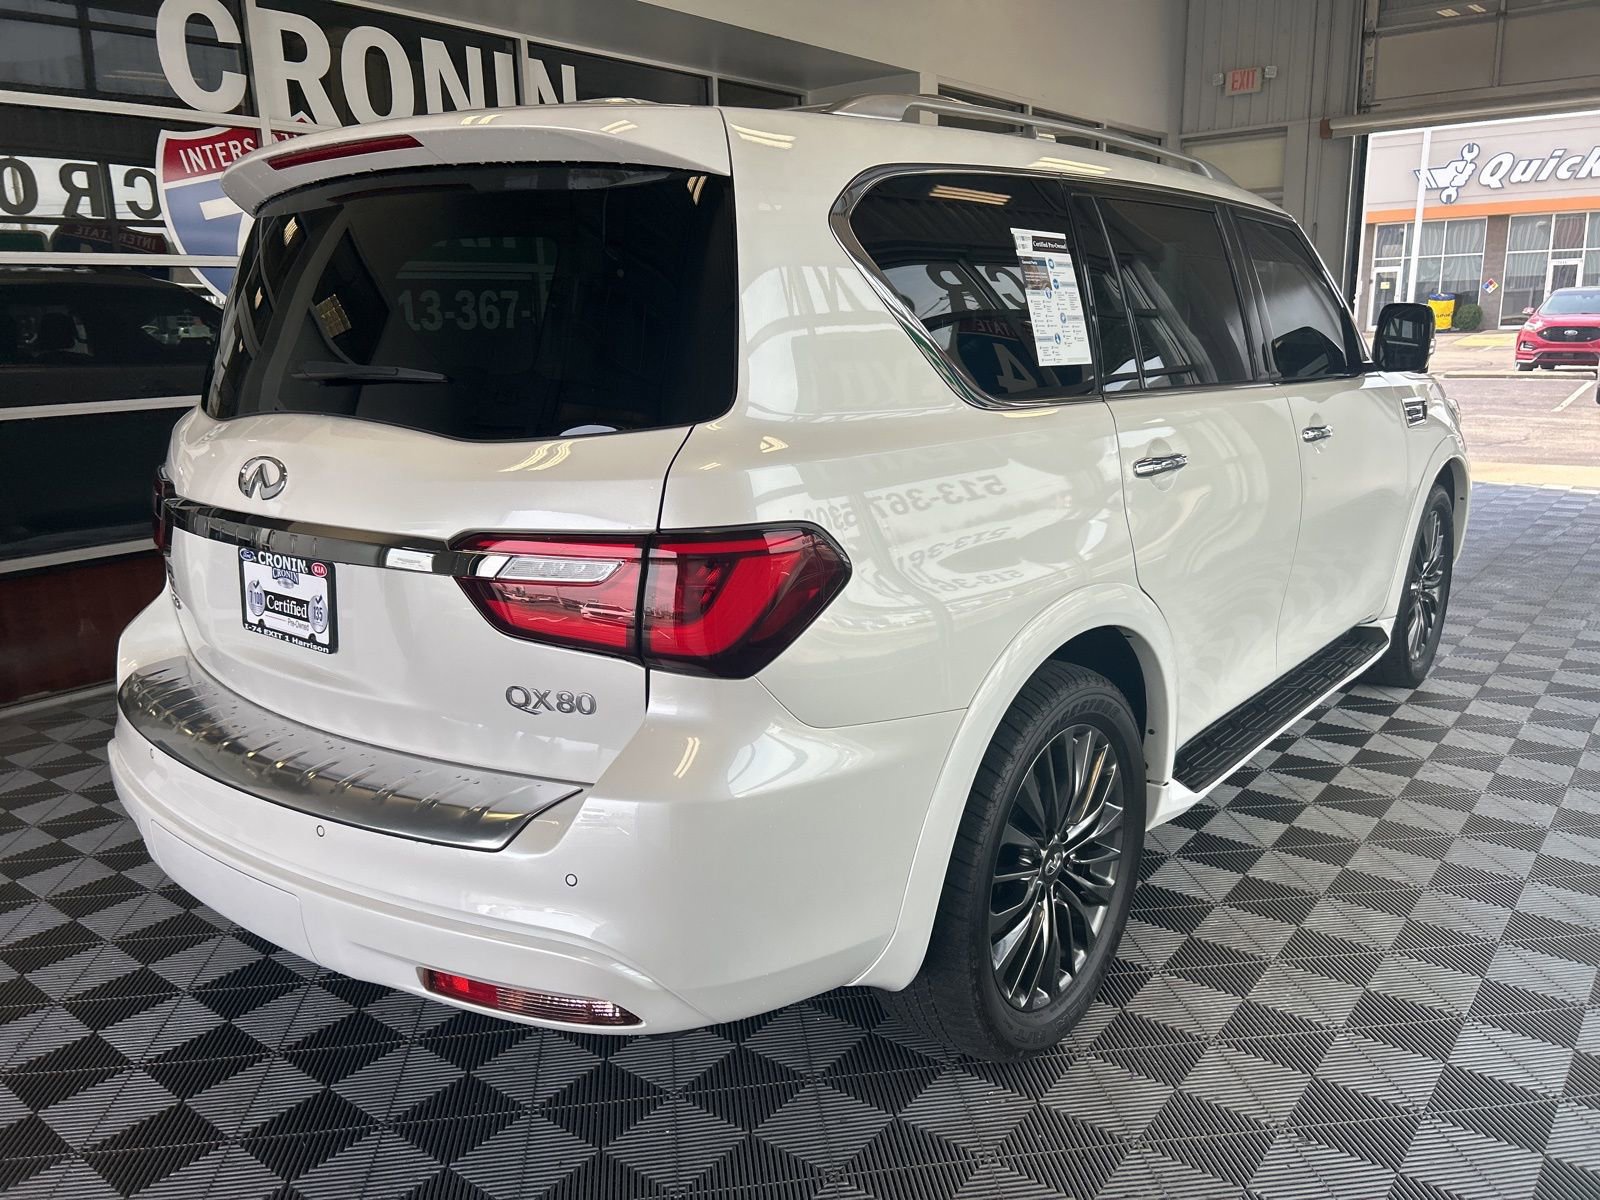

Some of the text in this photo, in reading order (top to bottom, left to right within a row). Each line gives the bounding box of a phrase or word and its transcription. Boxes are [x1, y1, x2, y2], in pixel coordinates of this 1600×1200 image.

[156, 0, 577, 127] CRONIN
[1231, 68, 1257, 91] EXIT
[258, 551, 307, 573] CRONIN
[313, 565, 325, 575] KIA
[273, 567, 299, 585] CRONIN
[266, 595, 308, 618] Certified
[263, 628, 284, 639] EXIT
[291, 637, 330, 654] Harrison
[505, 684, 597, 716] QX80
